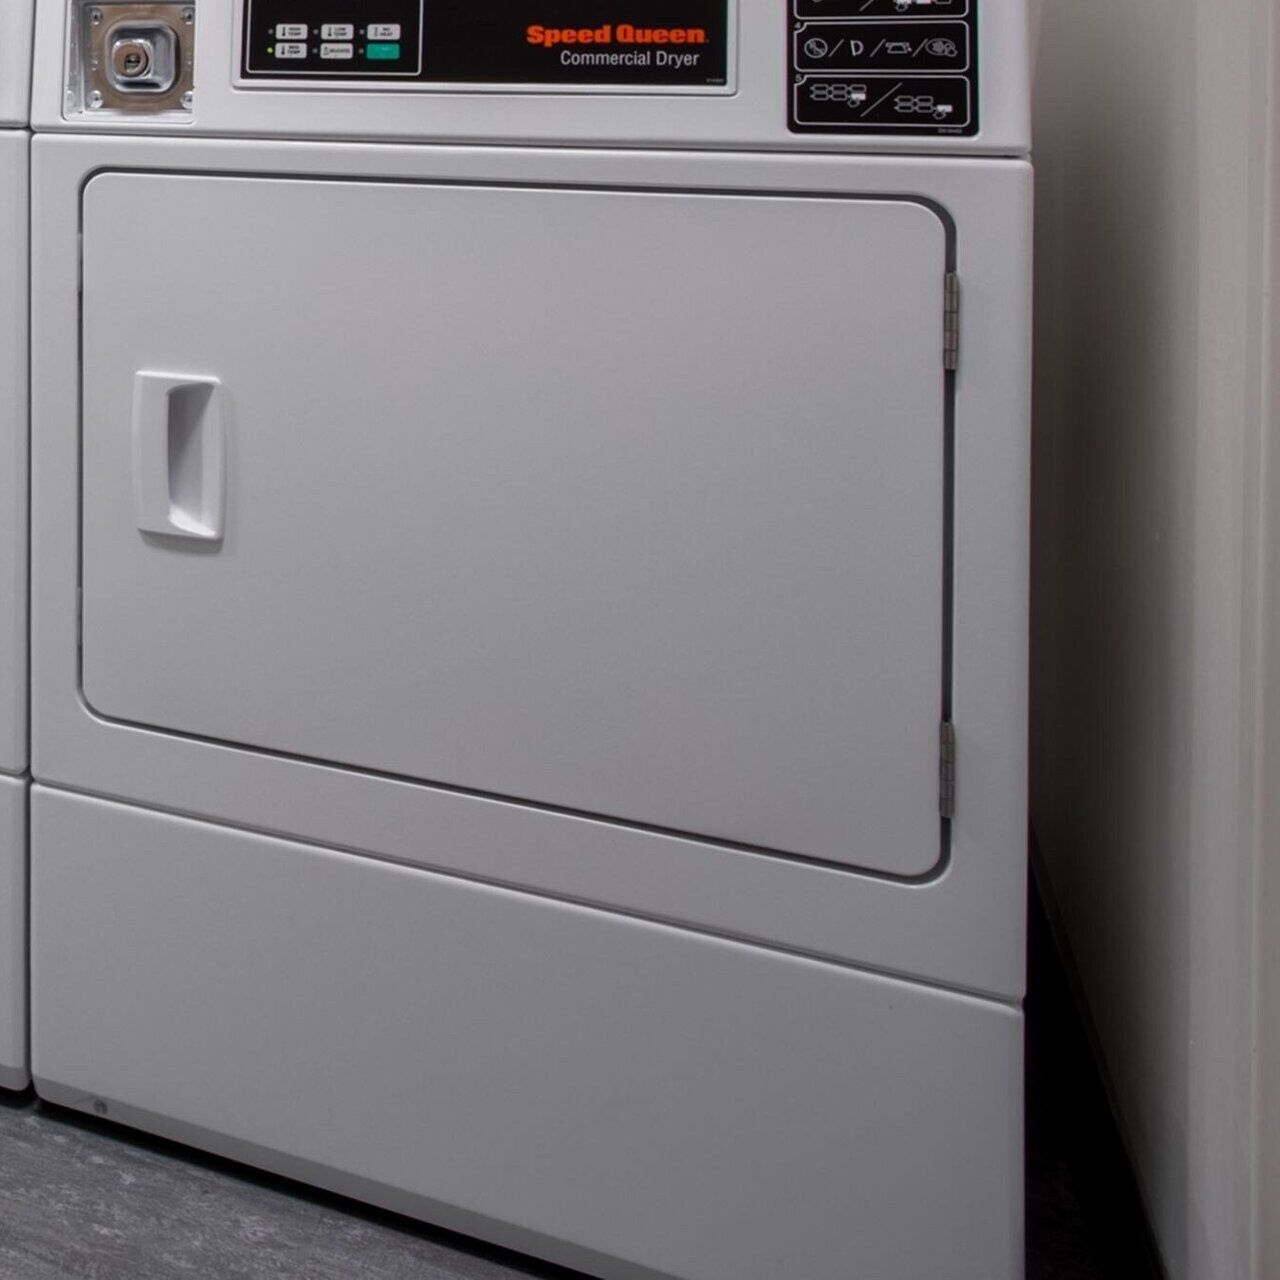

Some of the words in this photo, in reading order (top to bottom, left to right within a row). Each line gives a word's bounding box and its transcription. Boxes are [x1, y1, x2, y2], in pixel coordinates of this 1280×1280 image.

[526, 25, 611, 48] Speed
[616, 24, 705, 44] Queen
[560, 50, 651, 66] Commercial
[656, 51, 700, 69] Dryer
